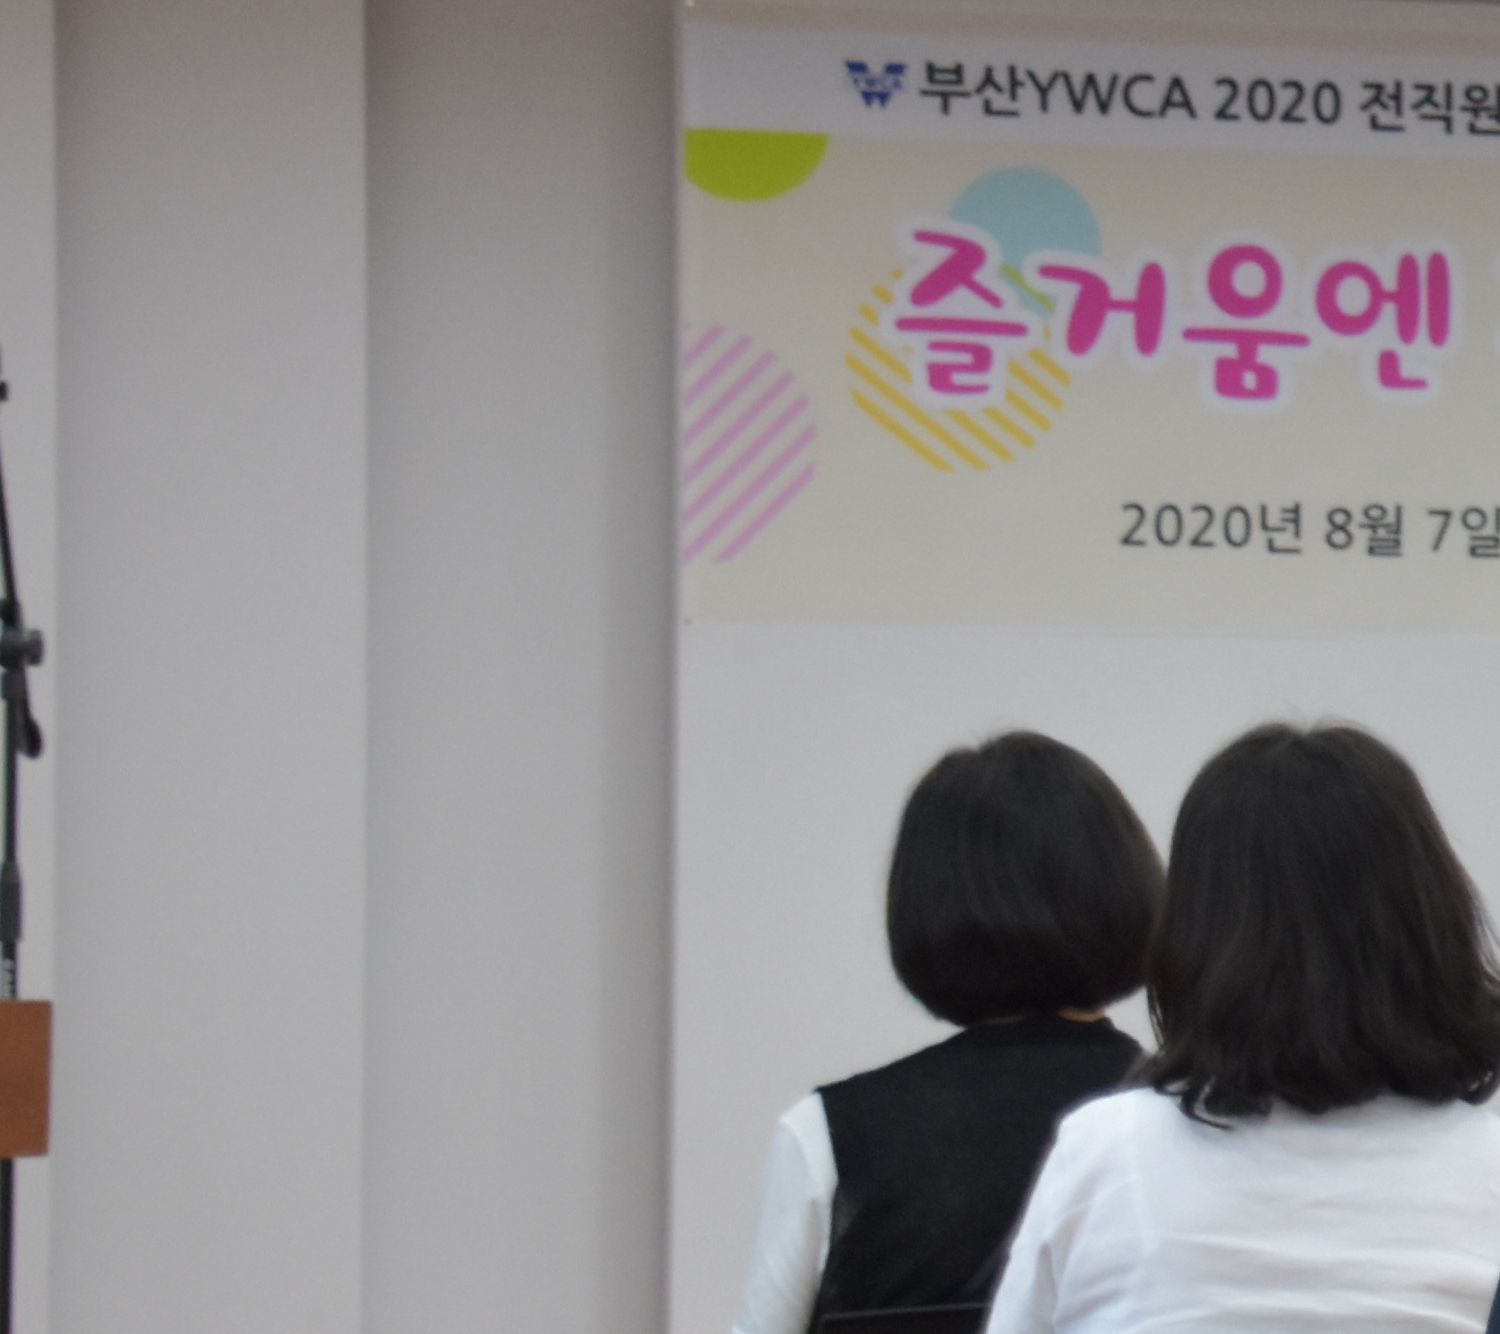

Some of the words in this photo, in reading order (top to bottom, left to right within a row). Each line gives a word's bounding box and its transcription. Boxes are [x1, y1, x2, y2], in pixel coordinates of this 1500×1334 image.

[919, 60, 1198, 120] 부산YWCA
[1213, 76, 1342, 125] 2020
[895, 230, 1451, 399] 즐거움엔
[1120, 501, 1302, 555] 2020년
[1324, 502, 1404, 558] 8월
